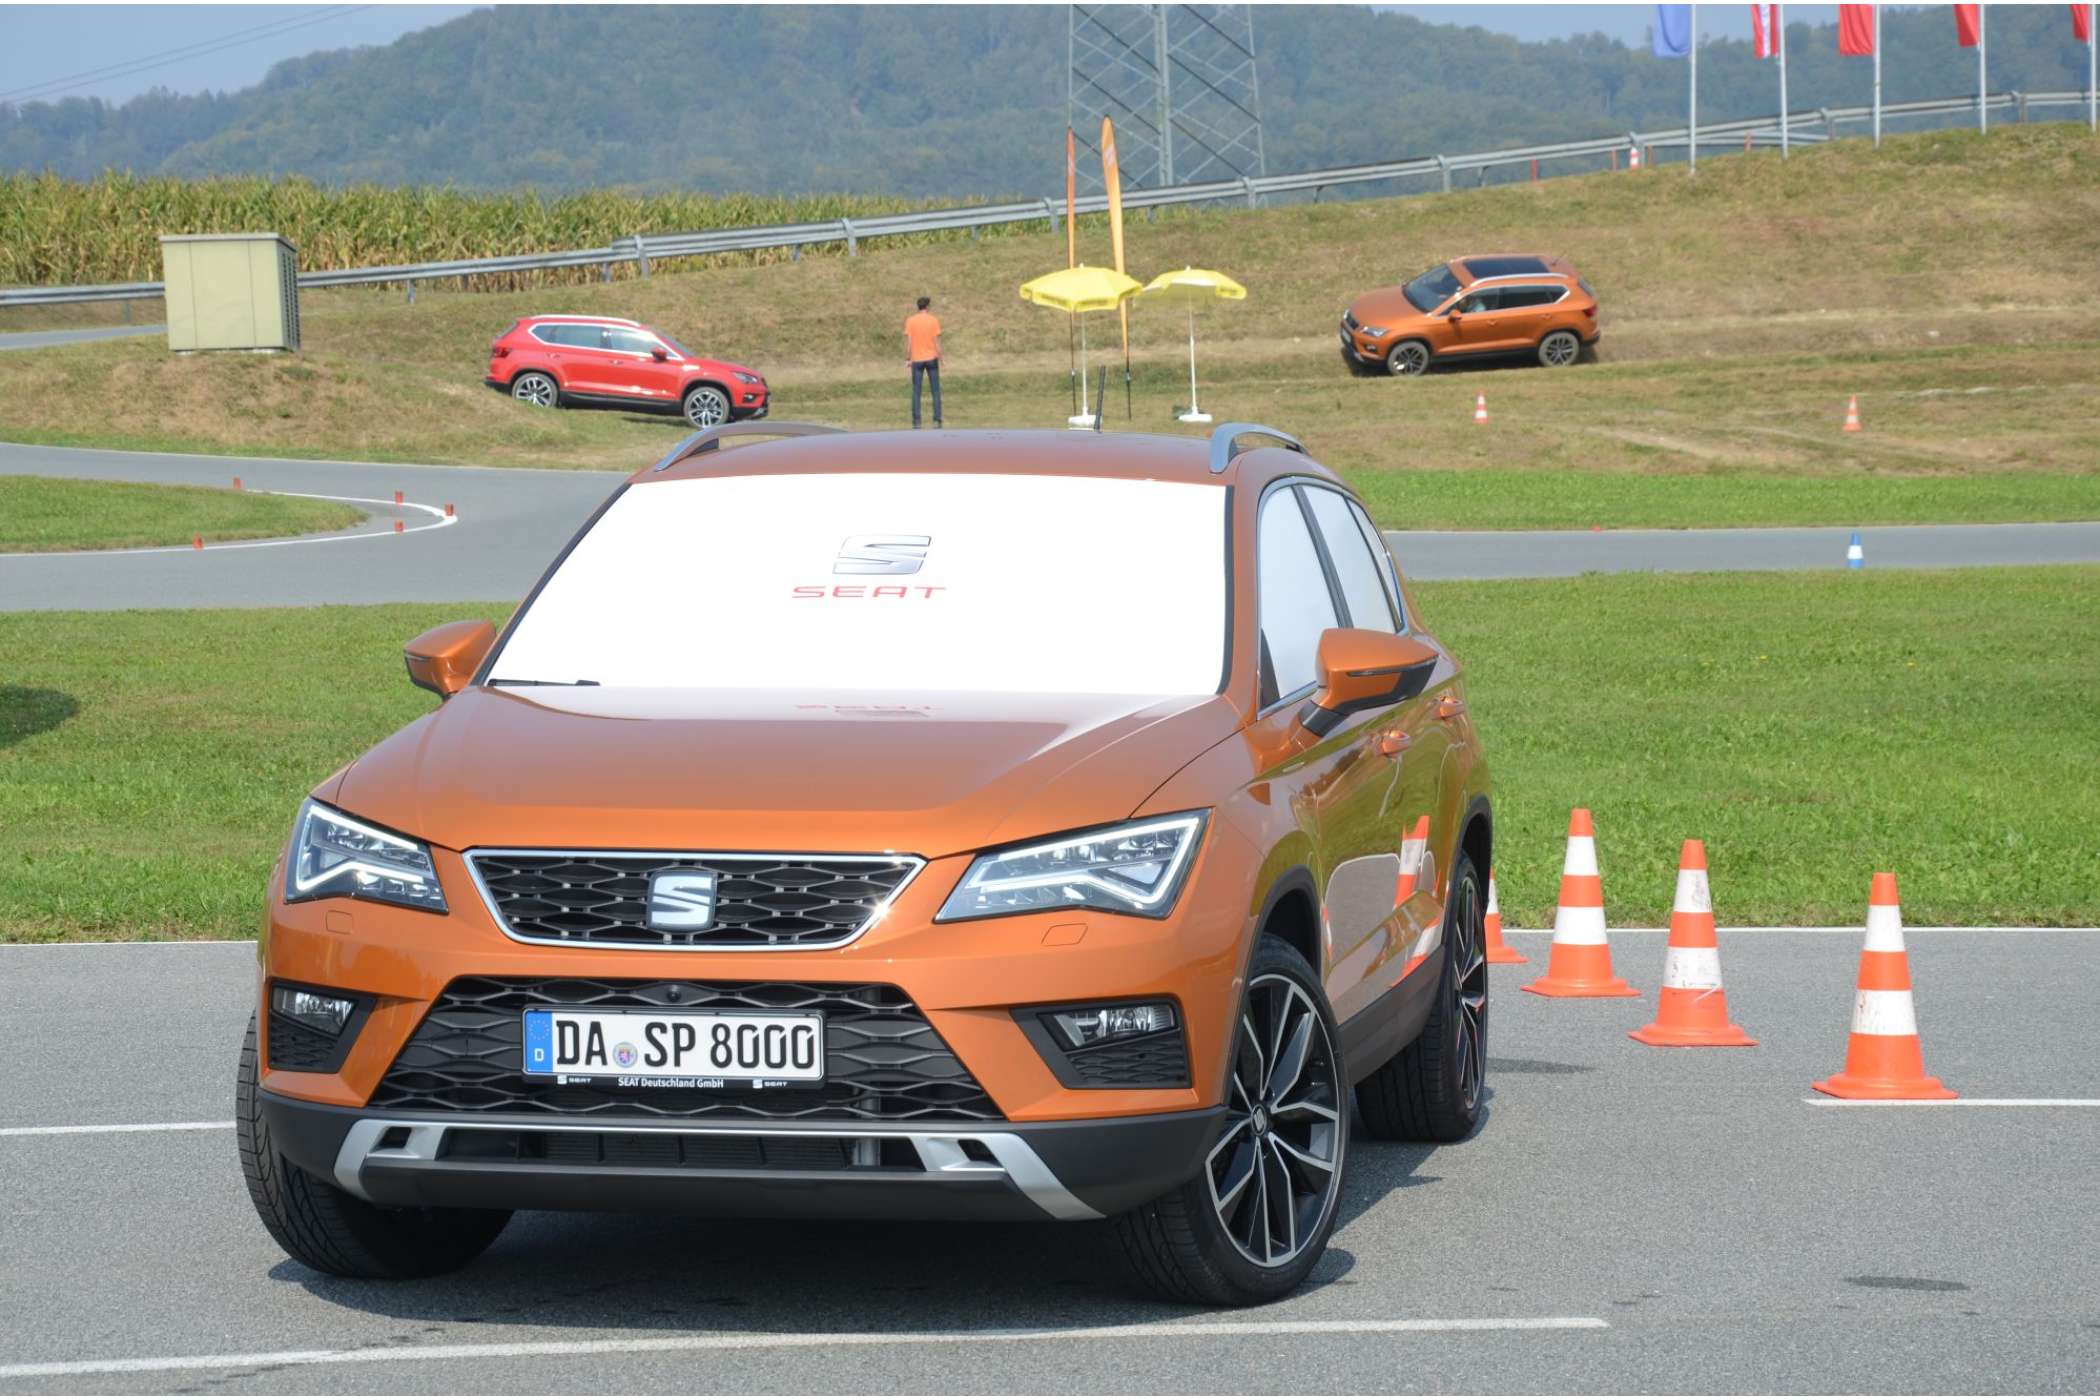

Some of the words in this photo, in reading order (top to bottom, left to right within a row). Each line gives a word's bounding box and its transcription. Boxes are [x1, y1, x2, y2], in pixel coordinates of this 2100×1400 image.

[792, 585, 946, 599] SEAT
[556, 1020, 608, 1066] DA
[644, 1021, 696, 1067] SP
[710, 1023, 814, 1069] 8000
[534, 1048, 544, 1062] D
[618, 1077, 639, 1087] SEAT
[641, 1078, 695, 1088] Deutschland
[697, 1079, 724, 1089] GmbH
